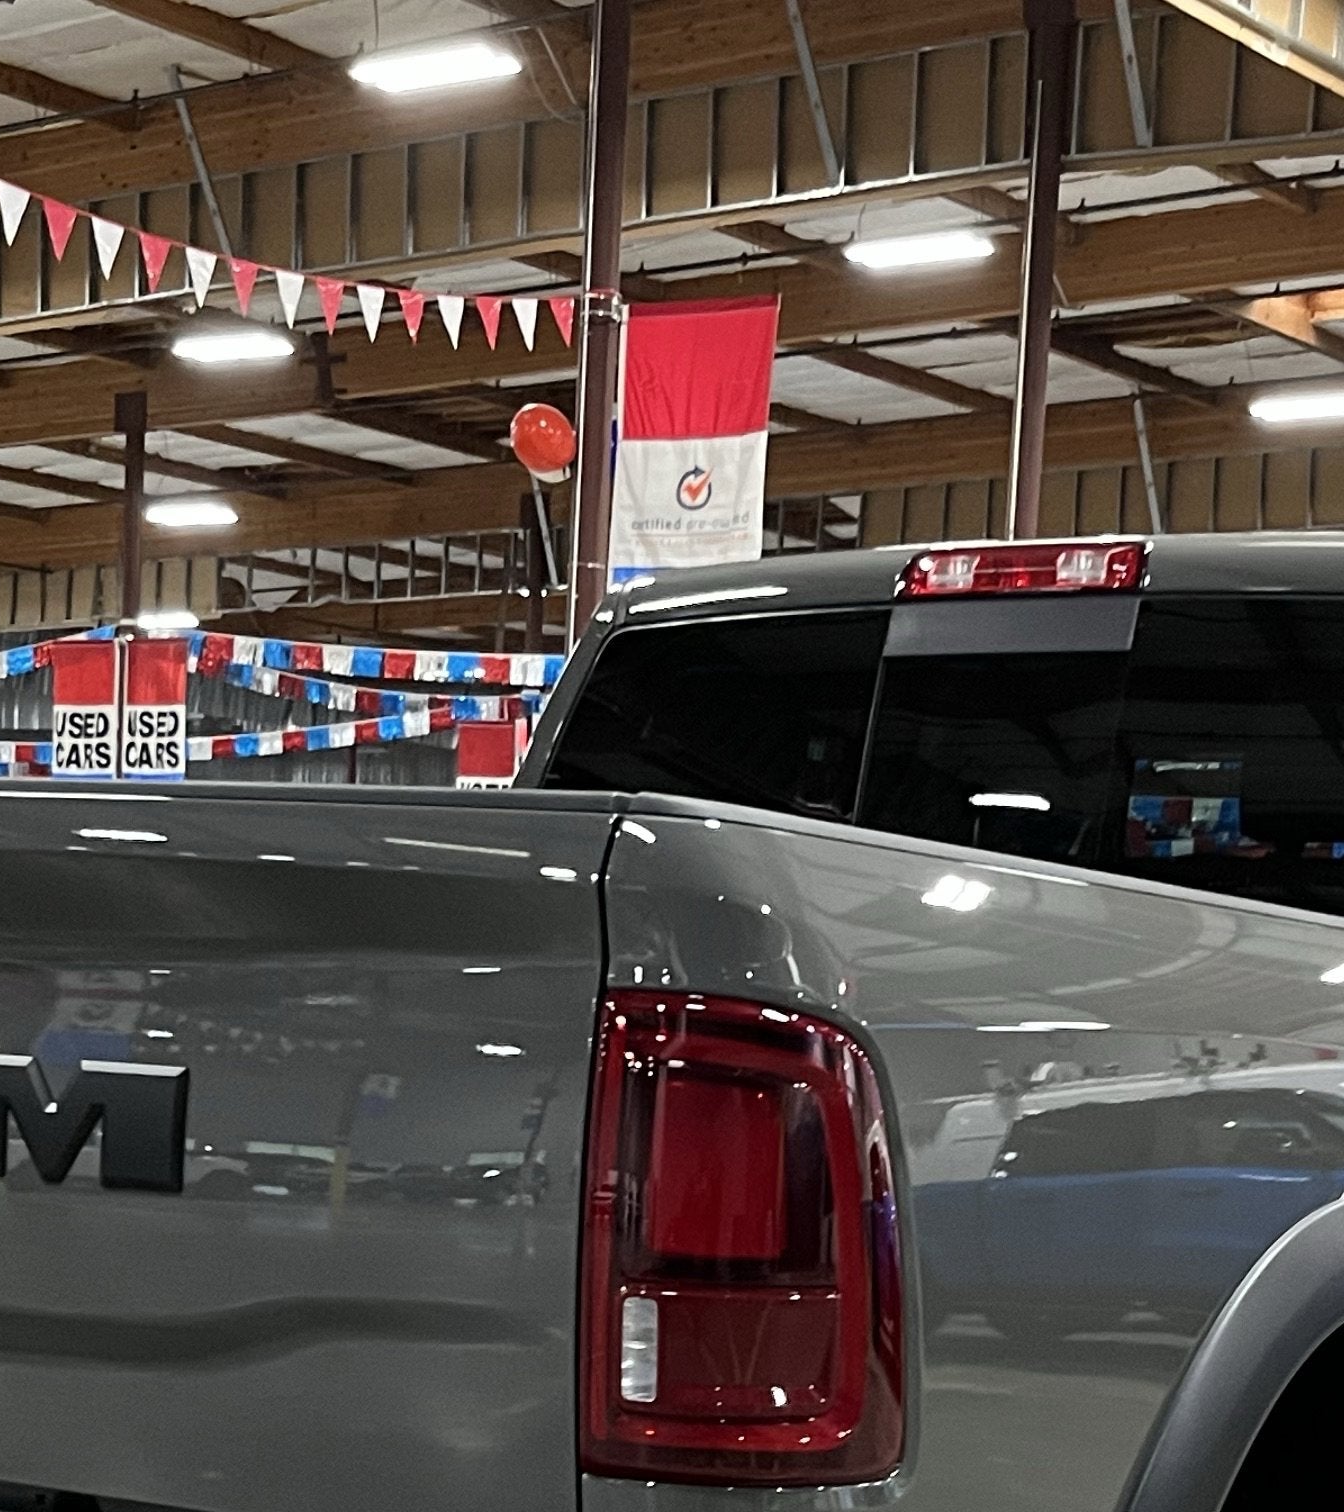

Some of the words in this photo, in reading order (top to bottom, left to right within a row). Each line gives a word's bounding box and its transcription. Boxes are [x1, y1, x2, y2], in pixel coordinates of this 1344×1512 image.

[56, 710, 110, 739] USED
[127, 711, 180, 738] USED
[55, 741, 112, 769] CARS
[125, 741, 180, 769] CARS
